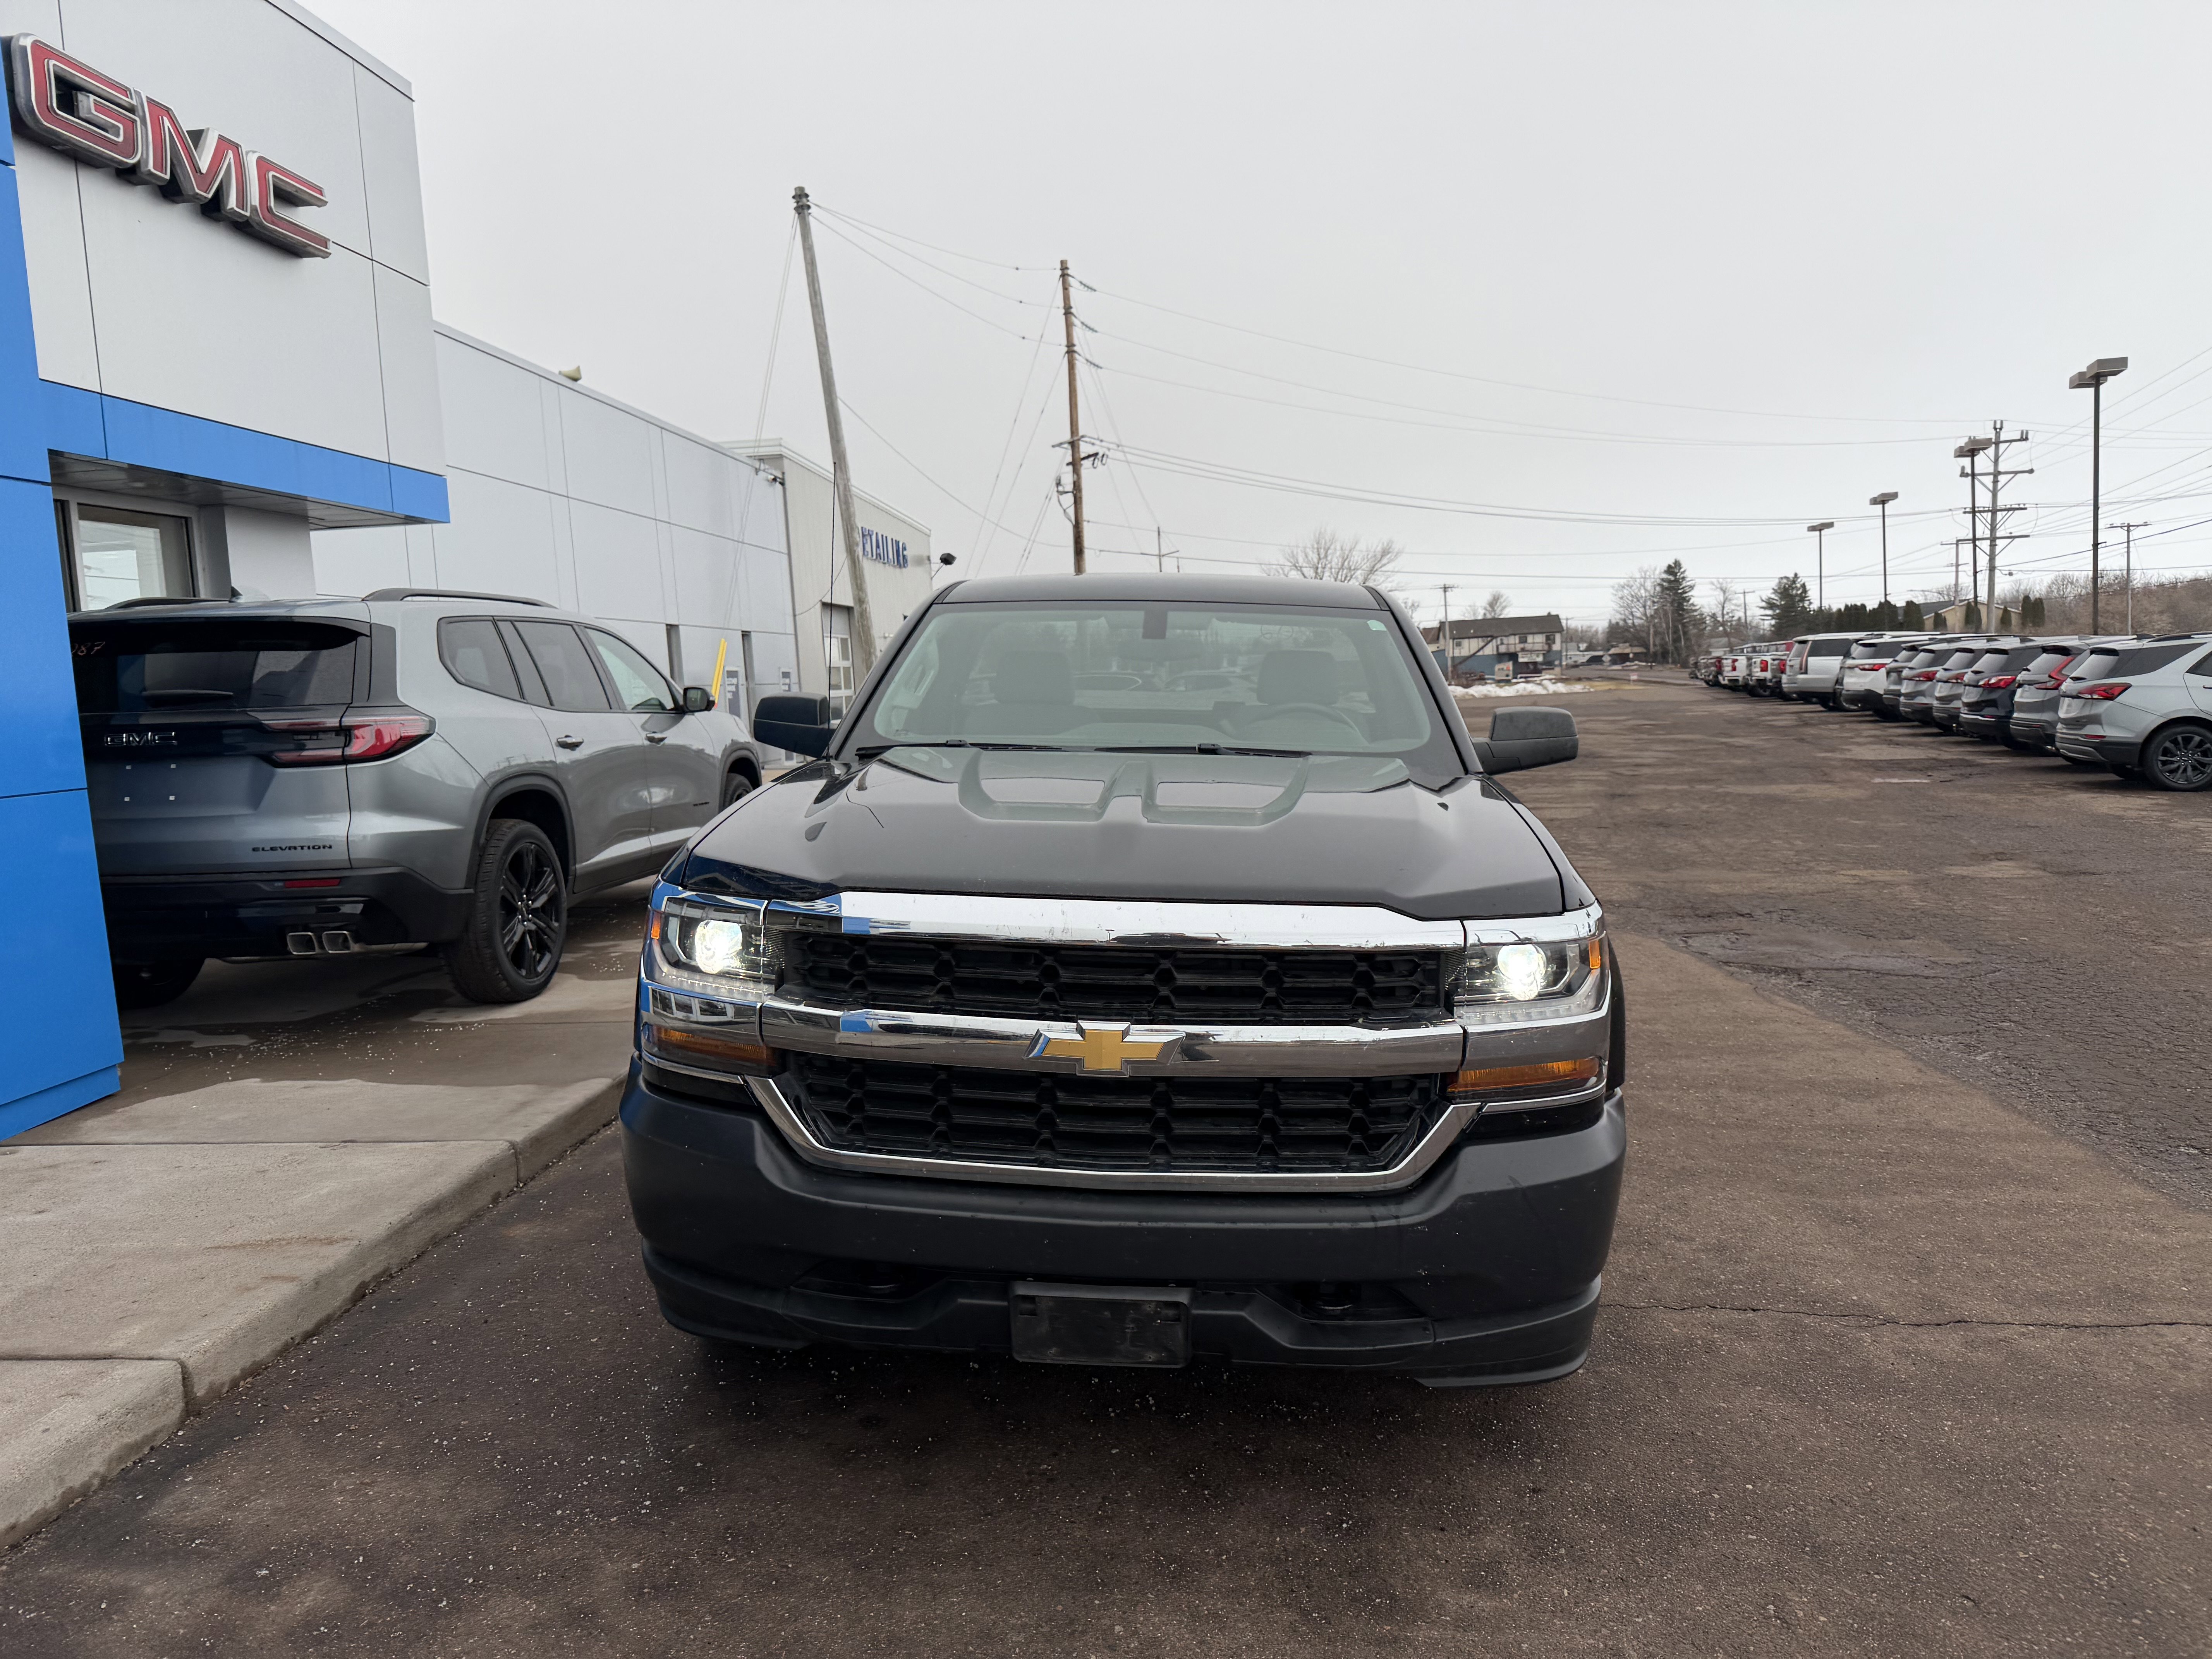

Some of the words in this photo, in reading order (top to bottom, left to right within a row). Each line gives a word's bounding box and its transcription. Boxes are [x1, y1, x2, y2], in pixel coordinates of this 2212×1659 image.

[12, 33, 331, 258] GMC
[861, 526, 908, 568] ETAILING
[104, 732, 178, 747] GMC
